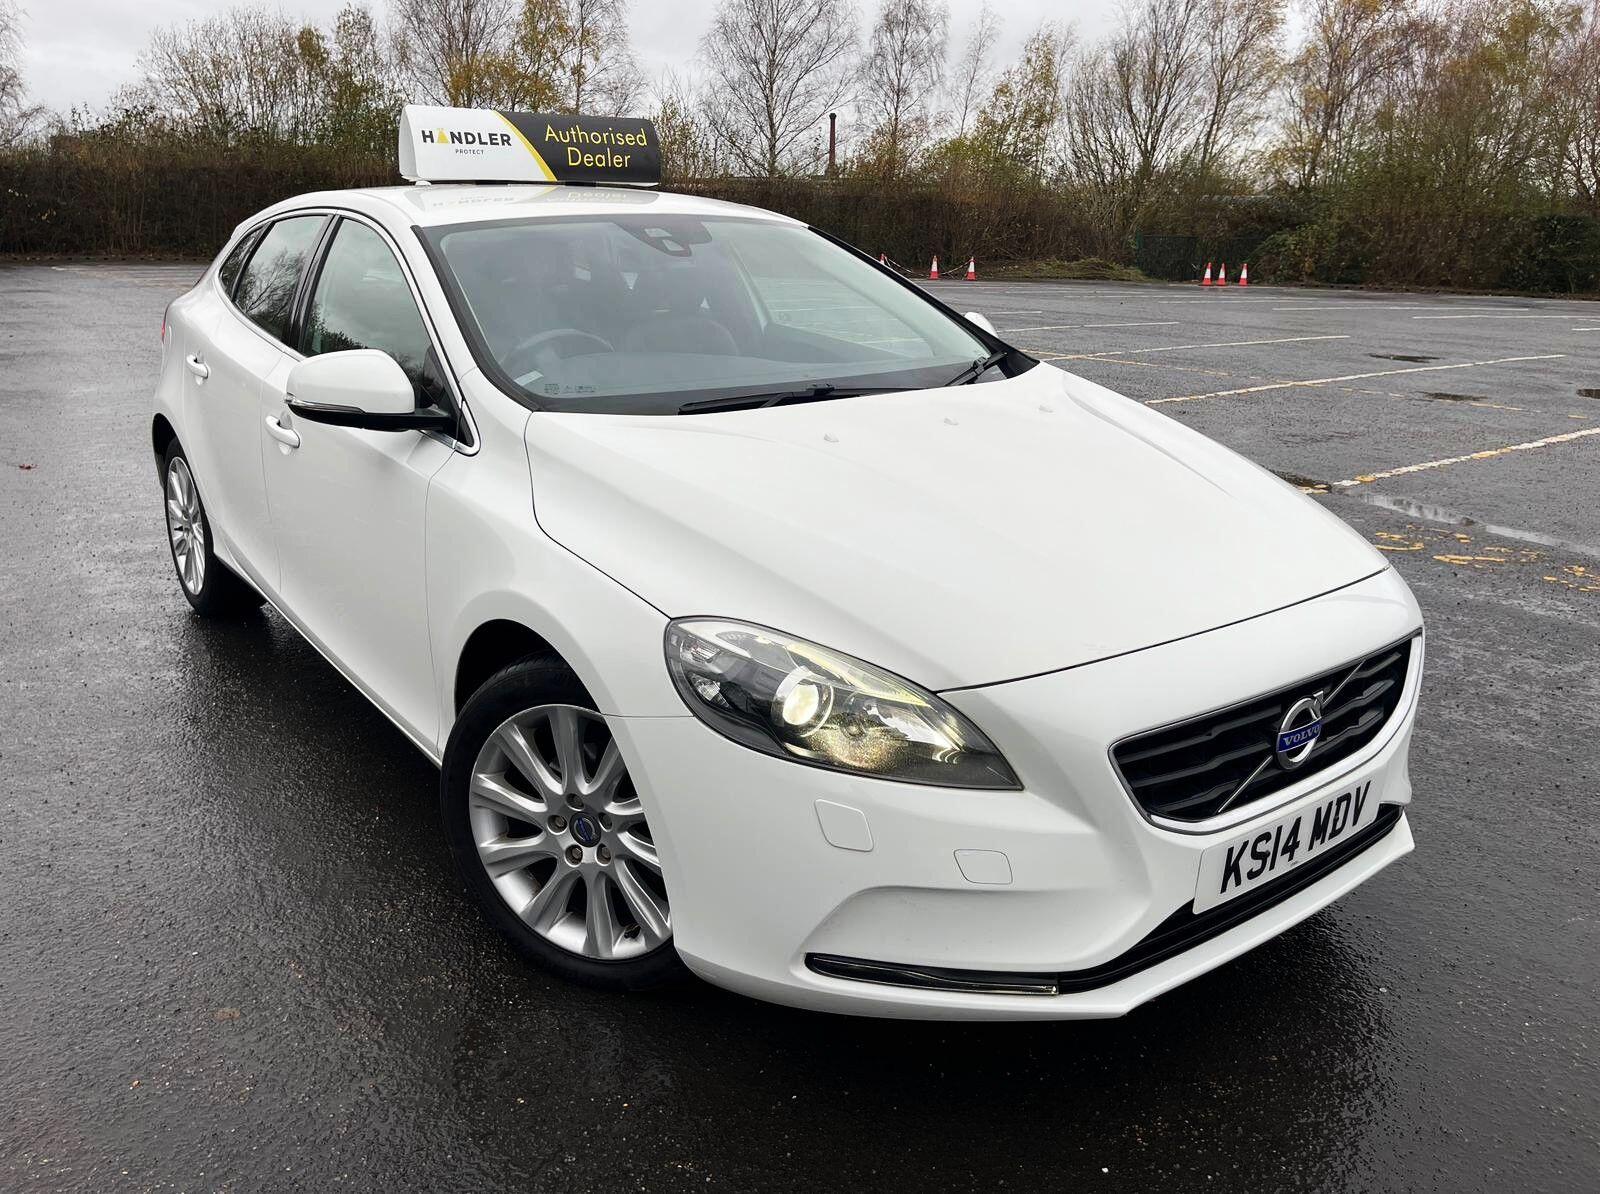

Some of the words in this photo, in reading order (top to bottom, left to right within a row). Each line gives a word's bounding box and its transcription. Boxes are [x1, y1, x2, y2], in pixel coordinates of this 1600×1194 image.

[545, 124, 648, 146] Authorised
[567, 147, 631, 168] Dealer
[1283, 724, 1321, 746] VOLVO
[1220, 816, 1302, 894] KS14
[1308, 780, 1372, 852] MDV
